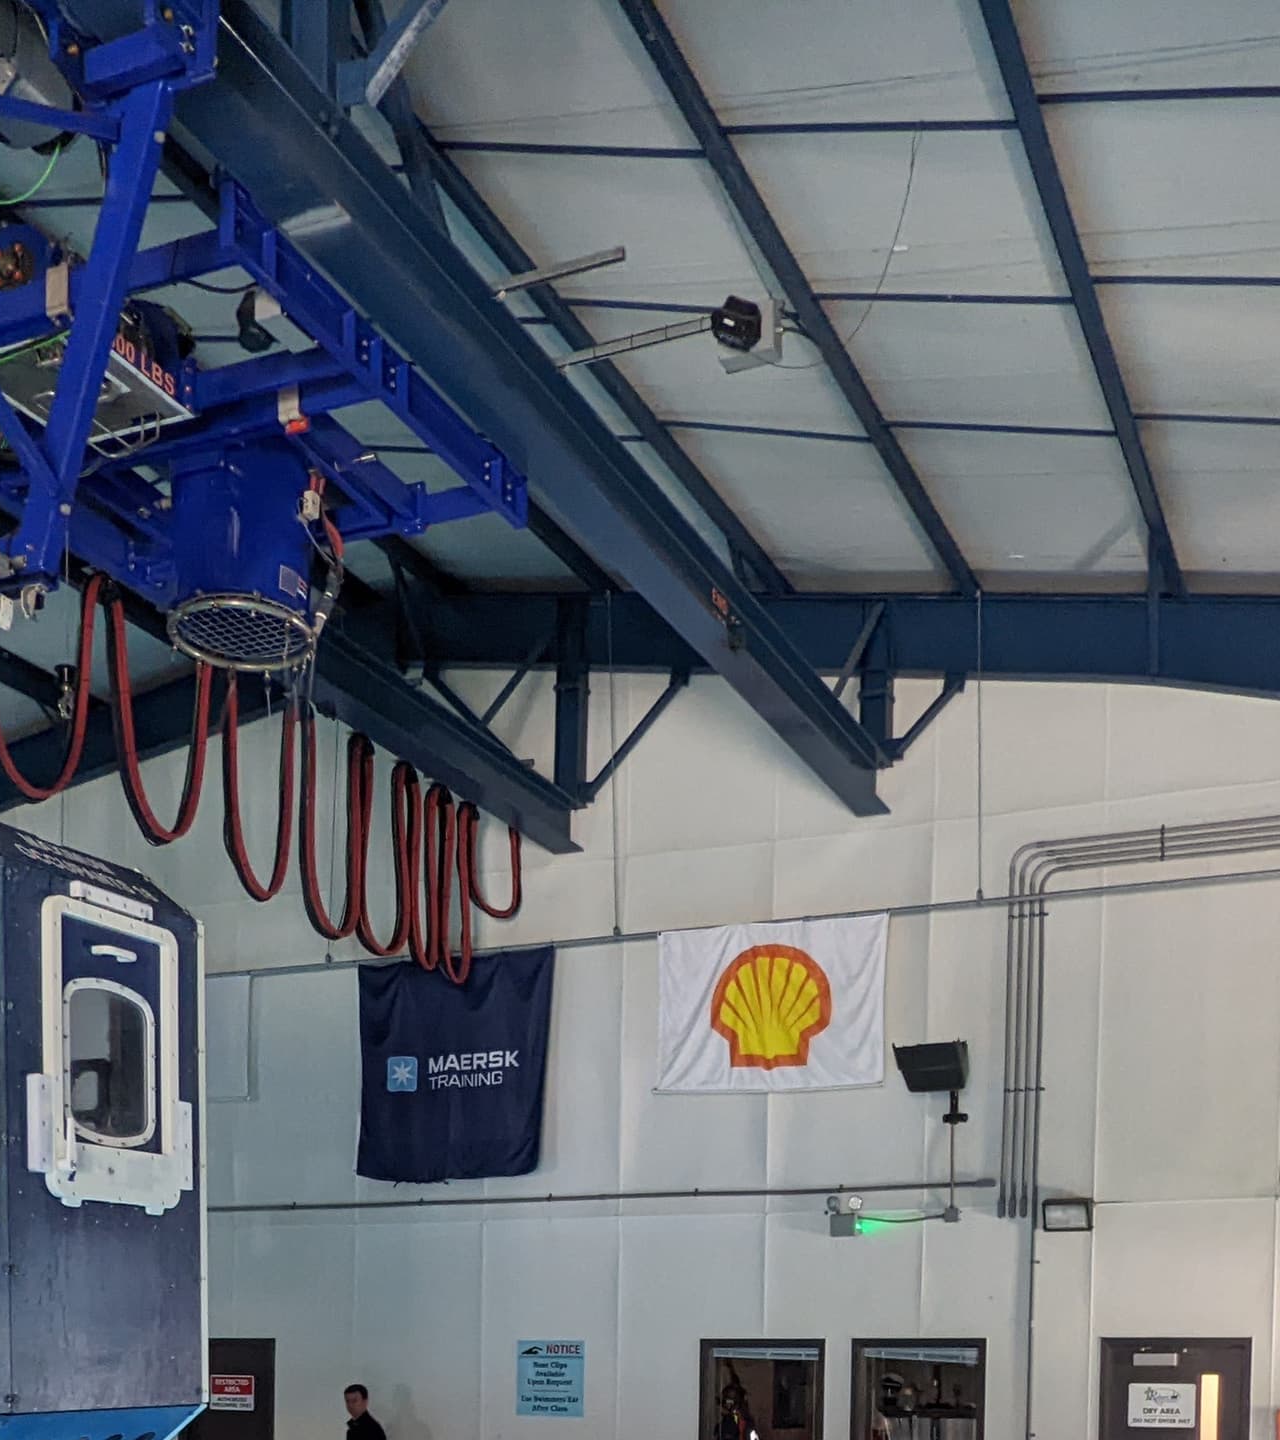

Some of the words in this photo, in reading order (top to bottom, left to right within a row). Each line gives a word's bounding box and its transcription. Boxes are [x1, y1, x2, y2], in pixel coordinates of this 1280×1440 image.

[112, 333, 135, 363] 00
[141, 352, 175, 395] LBS
[428, 1050, 520, 1074] MAERSK
[429, 1070, 504, 1090] TRAINING
[546, 1344, 581, 1354] NOTICE
